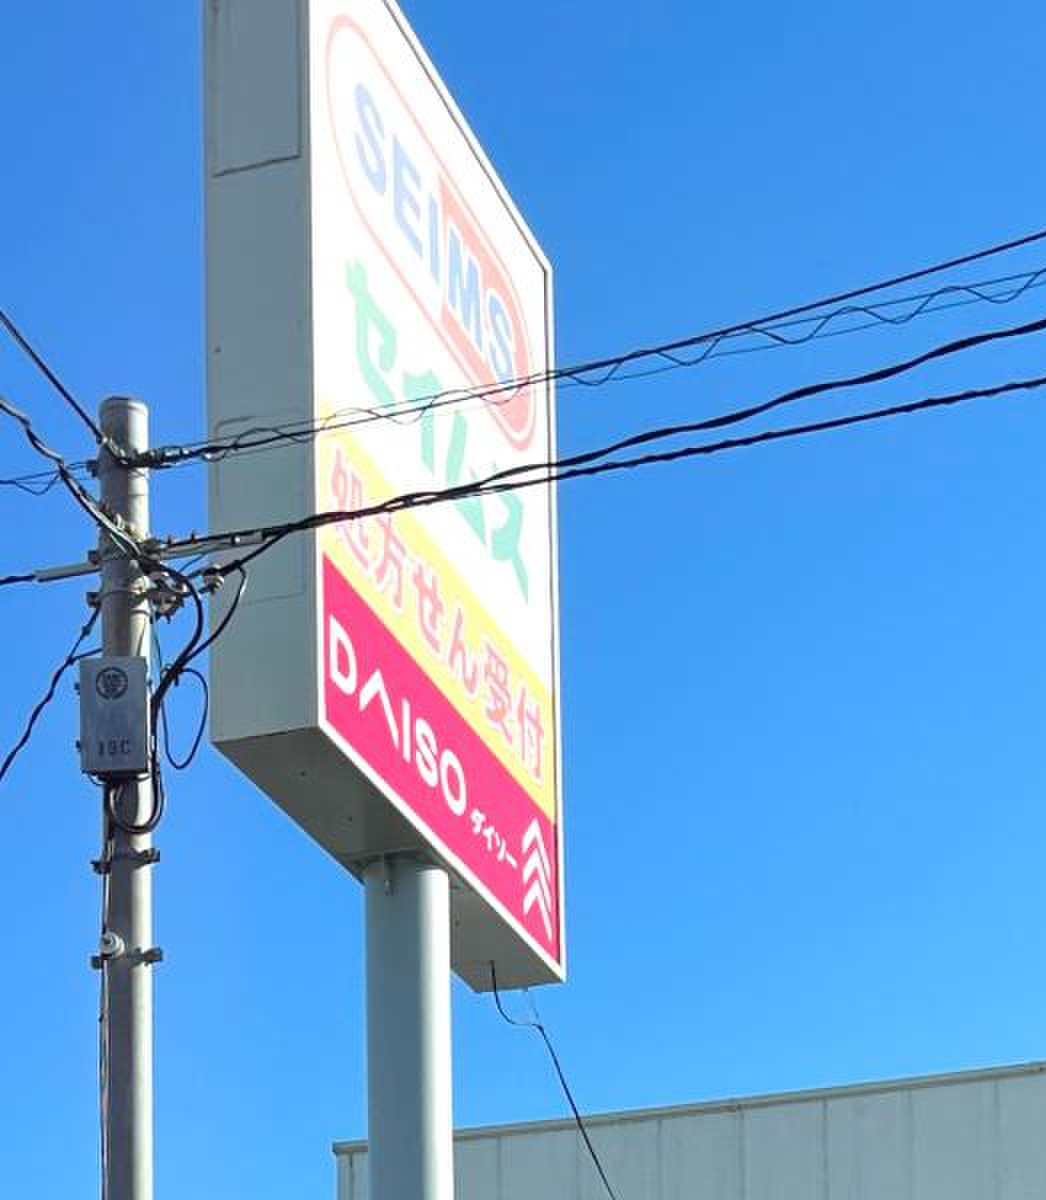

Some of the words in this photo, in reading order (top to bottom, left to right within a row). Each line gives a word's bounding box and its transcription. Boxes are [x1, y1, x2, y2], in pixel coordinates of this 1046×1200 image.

[352, 81, 515, 384] SEIMS
[345, 257, 530, 604] セイムス
[330, 446, 546, 781] 処方せん受付
[330, 614, 467, 816] DAISO
[471, 808, 518, 869] ダイソー
